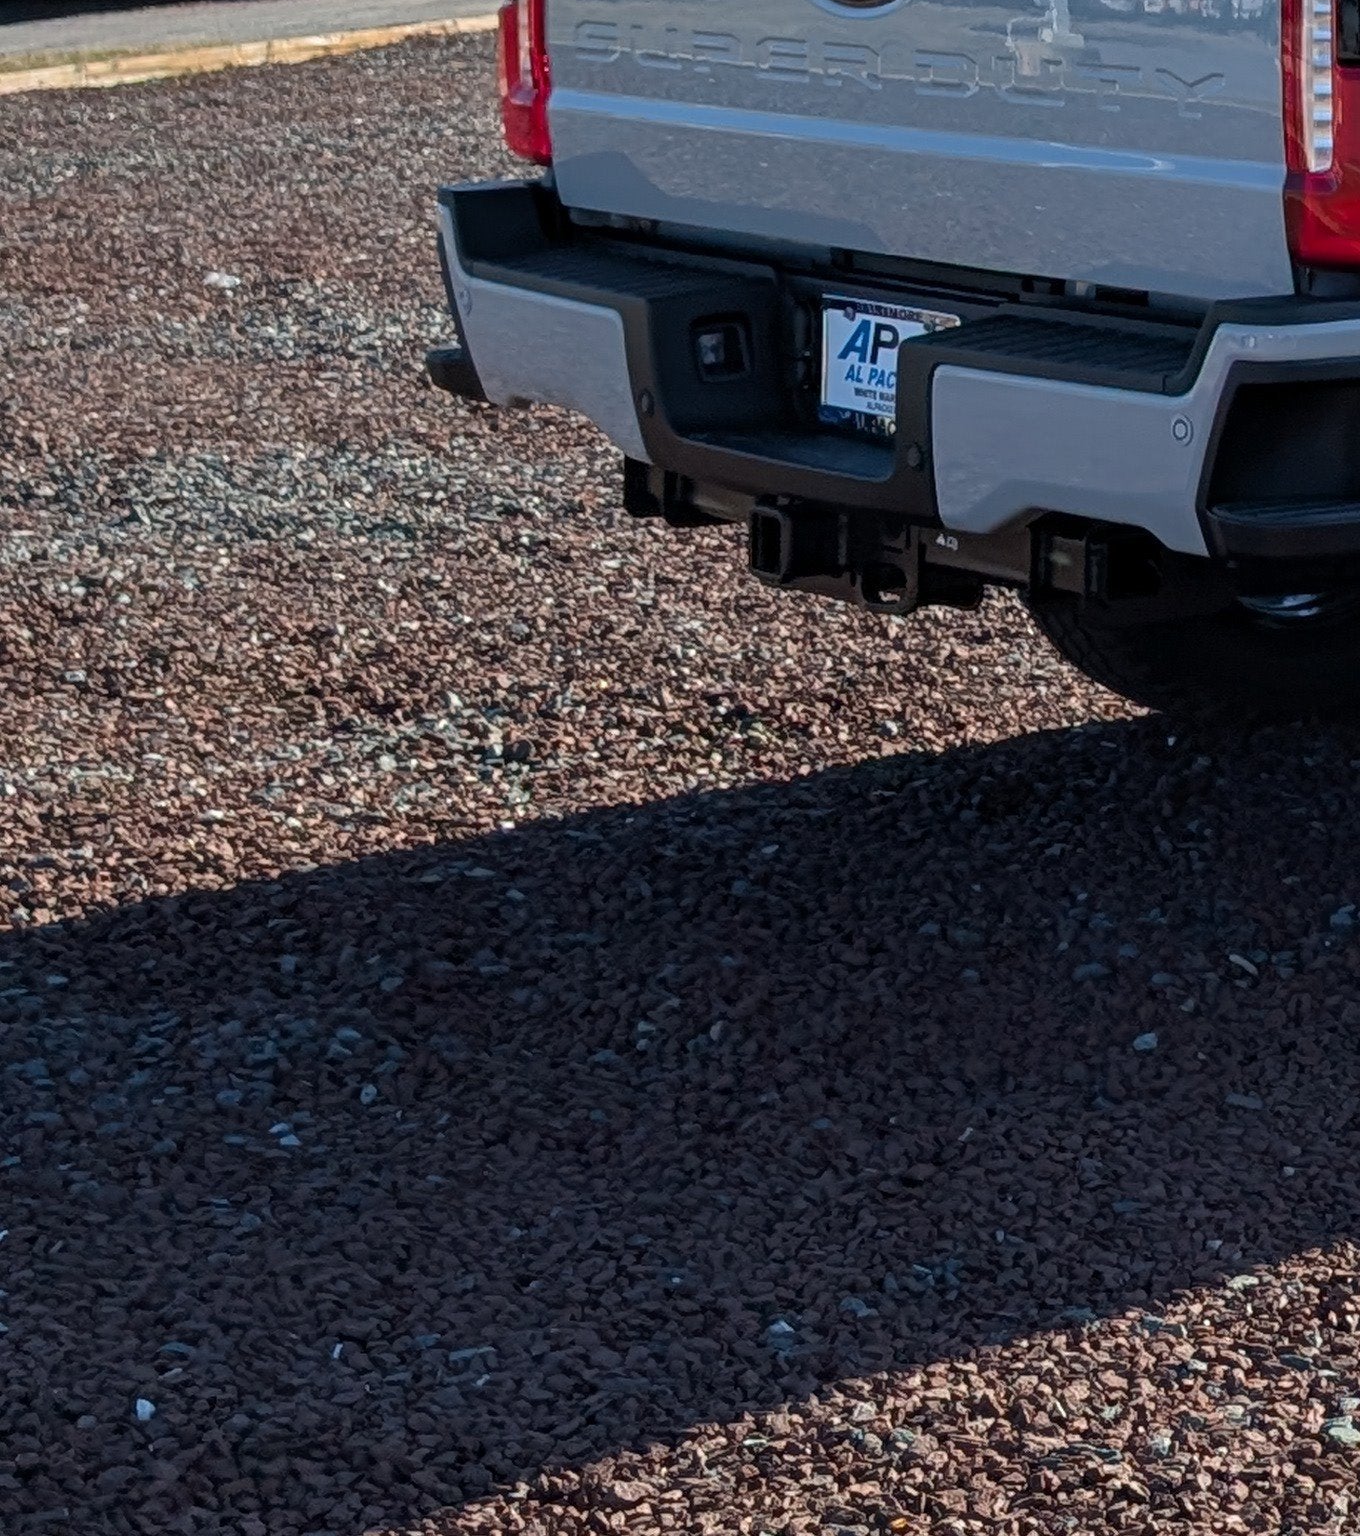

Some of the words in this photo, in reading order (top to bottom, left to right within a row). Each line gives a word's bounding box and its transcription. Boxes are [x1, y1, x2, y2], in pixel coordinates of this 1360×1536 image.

[575, 20, 883, 92] SUPER
[912, 47, 1226, 120] DUTY
[837, 319, 900, 366] AP
[844, 364, 864, 384] AL
[866, 367, 896, 390] PAC
